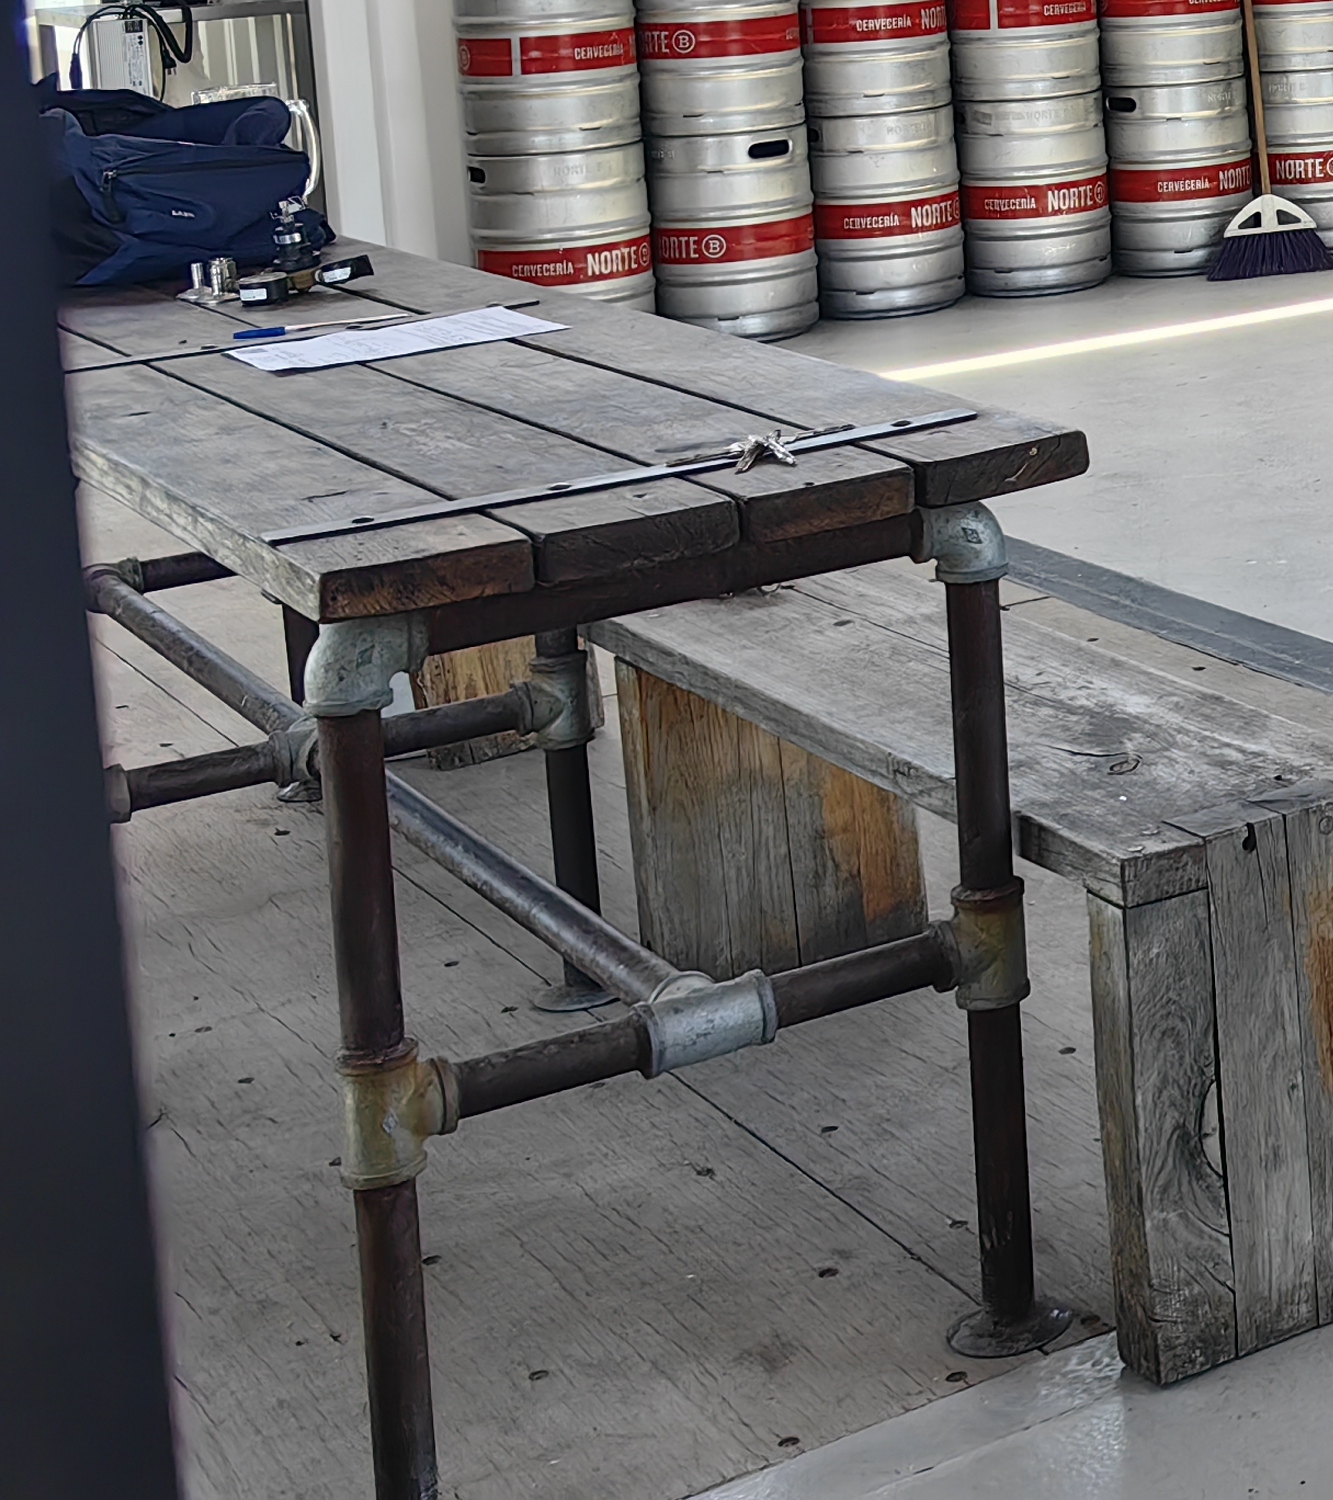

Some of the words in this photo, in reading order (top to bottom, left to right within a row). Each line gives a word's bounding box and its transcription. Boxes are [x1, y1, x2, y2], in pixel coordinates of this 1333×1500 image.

[1275, 158, 1324, 181] NORTE
[1157, 176, 1210, 193] CERVECERÍA
[984, 197, 1036, 211] CERVECERÍA
[1047, 185, 1095, 213] NORTE
[843, 212, 900, 230] CERVECERÍA
[910, 200, 953, 229] NORTE
[512, 260, 574, 278] CERVECERÍA
[586, 246, 638, 277] NORTE
